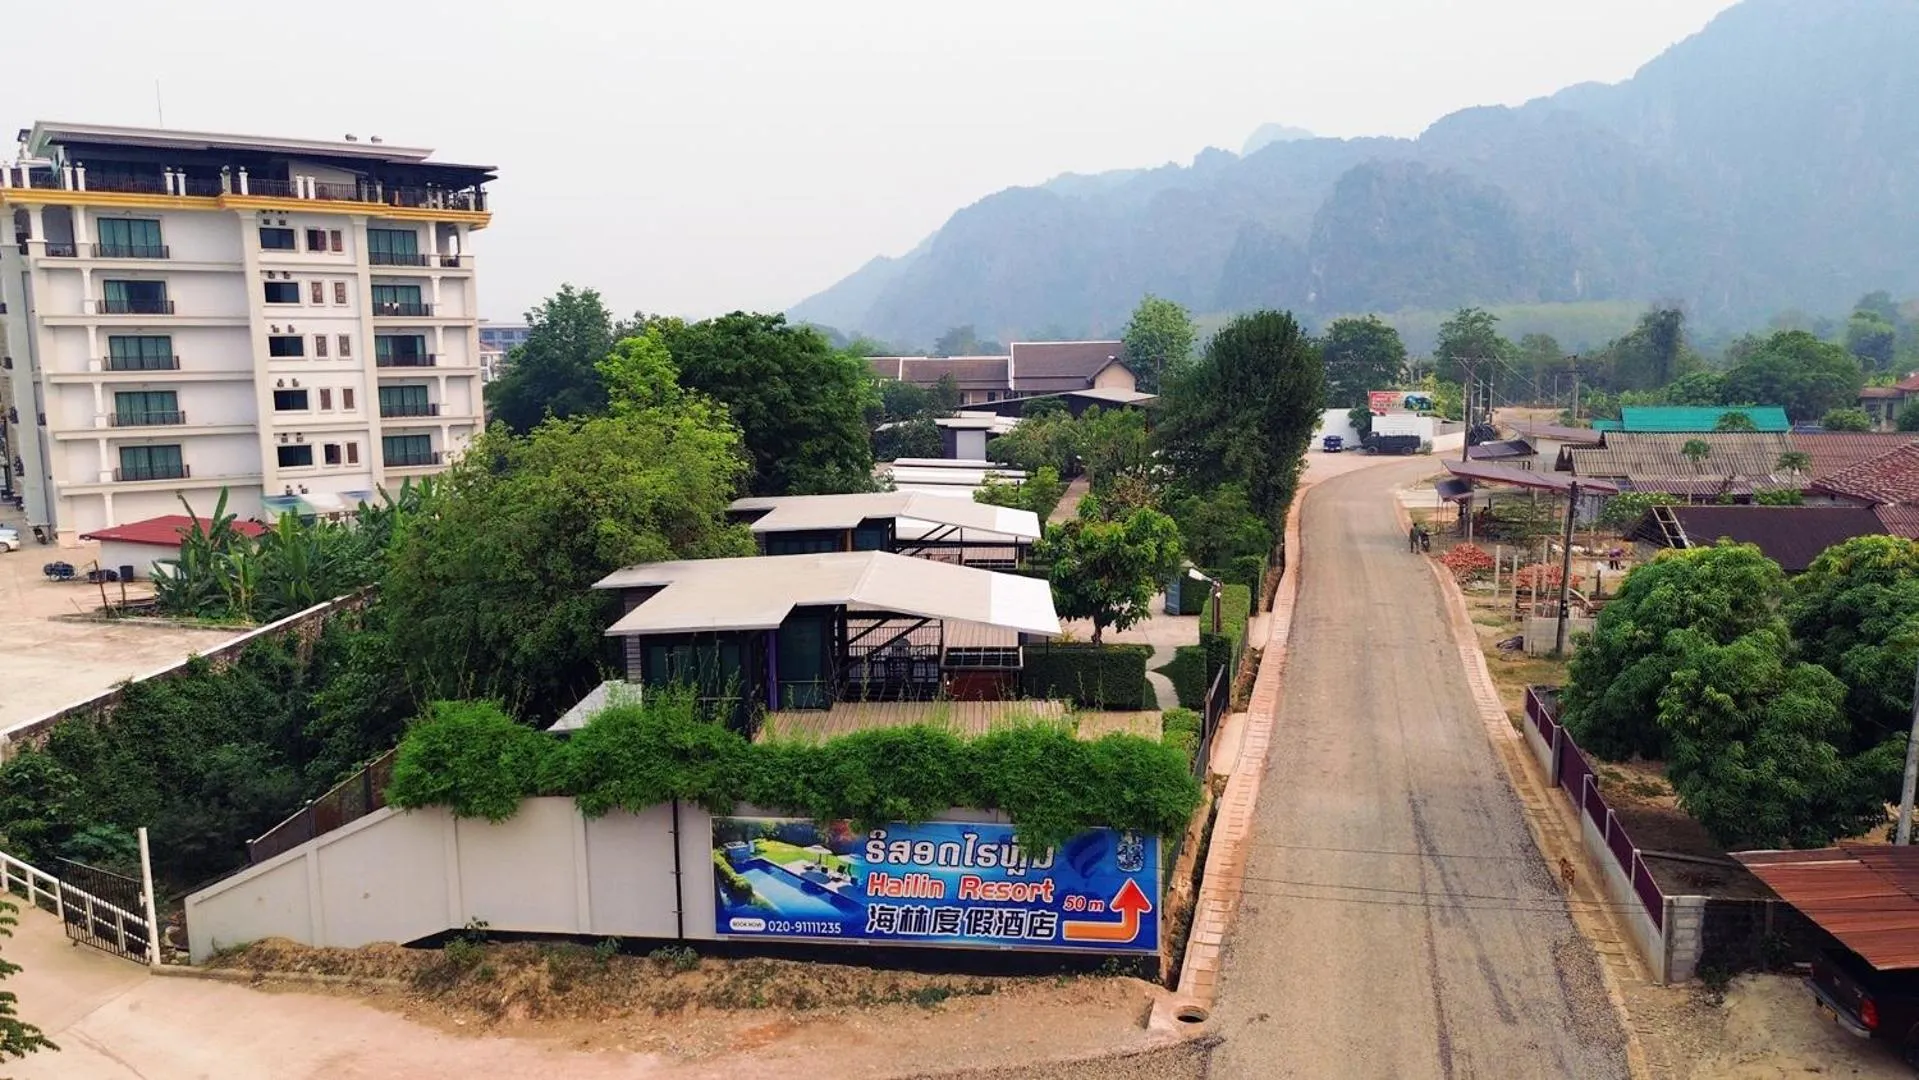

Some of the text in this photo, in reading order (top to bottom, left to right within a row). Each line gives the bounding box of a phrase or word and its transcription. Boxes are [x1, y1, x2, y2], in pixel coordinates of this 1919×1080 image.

[867, 872, 1055, 903] Hailin Resort
[1063, 895, 1104, 912] 50 m
[768, 920, 842, 934] 020-91111235
[866, 903, 1058, 940] 海林度假酒店
